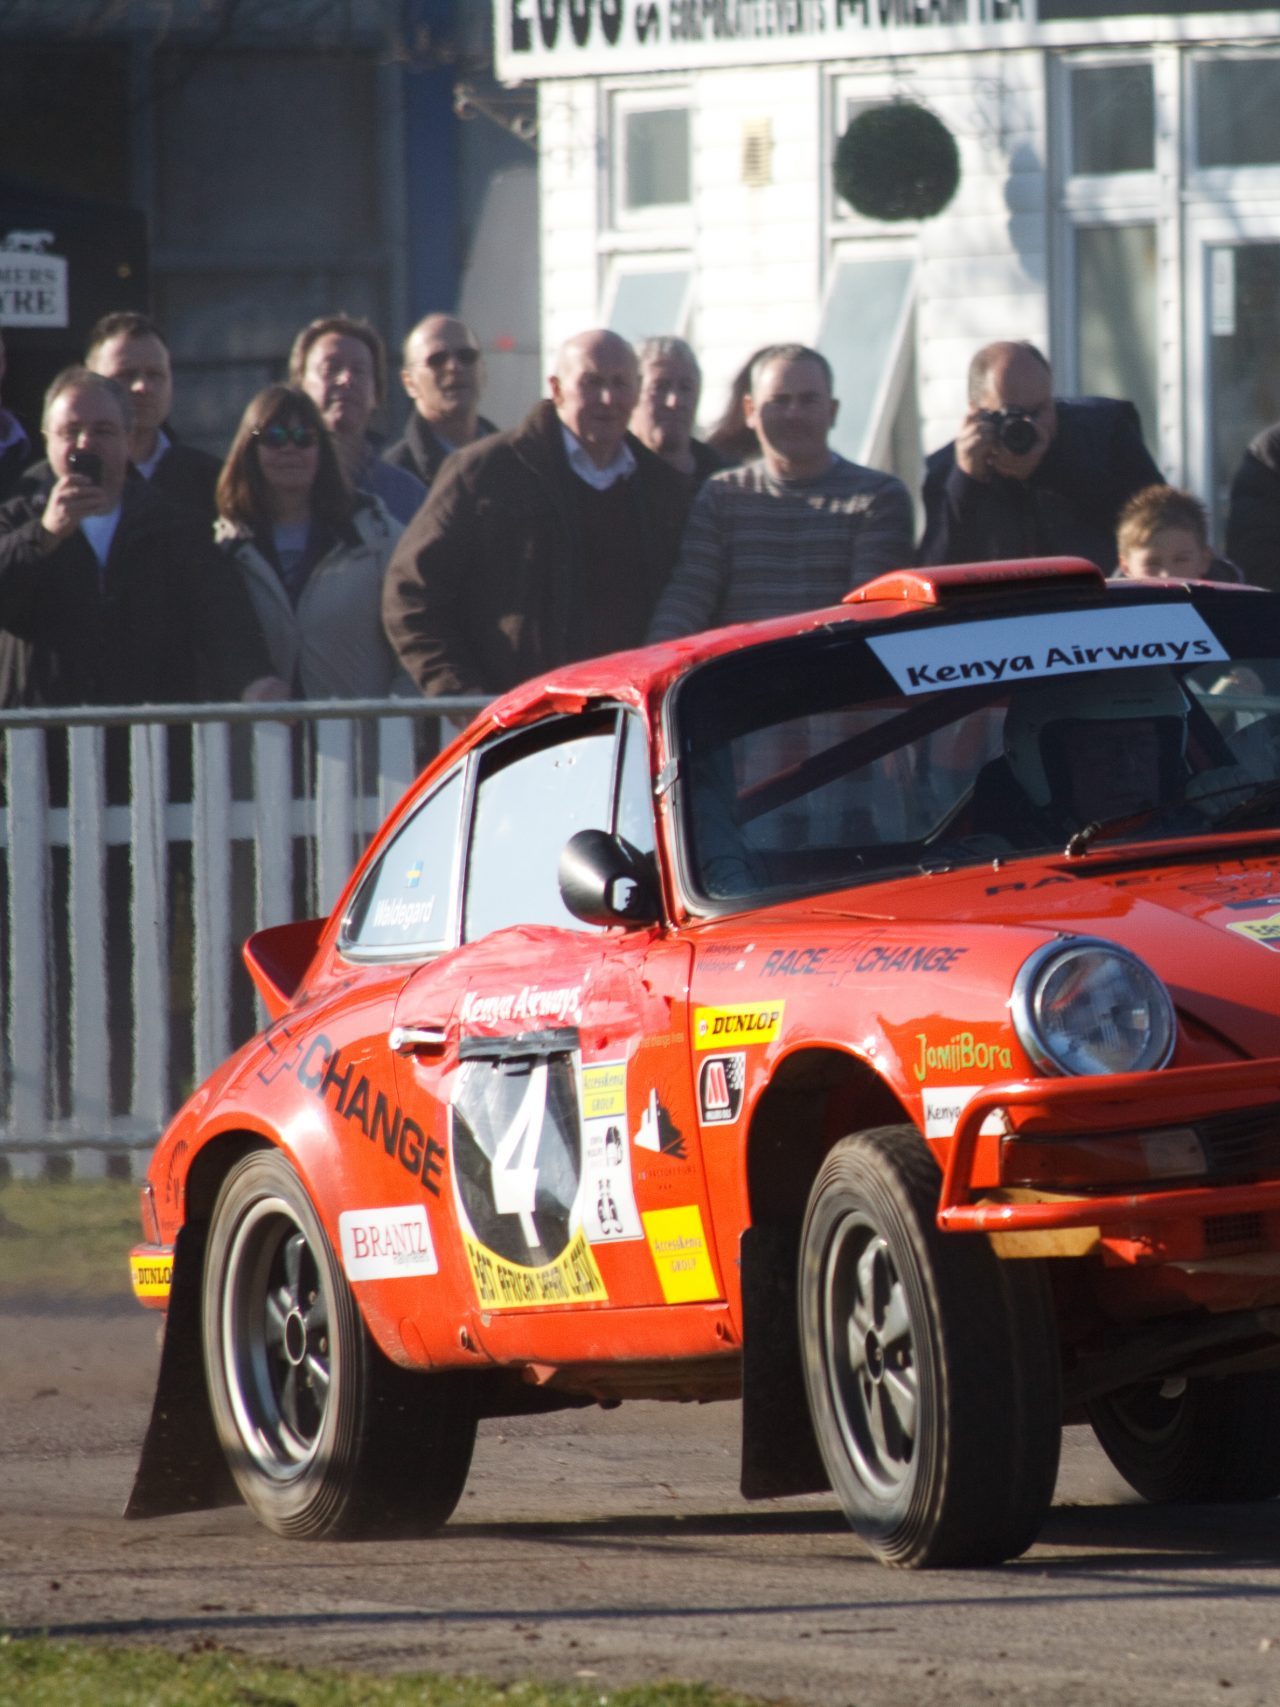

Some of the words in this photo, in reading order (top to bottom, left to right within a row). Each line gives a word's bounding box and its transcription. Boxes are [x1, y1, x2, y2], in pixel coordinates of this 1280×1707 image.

[906, 652, 1033, 688] Kenya
[1045, 638, 1213, 669] Airways
[759, 947, 829, 977] RACE
[855, 946, 970, 973] CHANGE
[460, 991, 514, 1028] Kenya
[513, 984, 583, 1022] Airways
[712, 1011, 780, 1035] DUNLOP
[913, 1032, 1013, 1082] JamiiBora
[296, 1033, 445, 1198] CHANGE
[926, 1103, 961, 1124] Kenya
[491, 1054, 548, 1248] 4
[350, 1221, 428, 1259] BRANTZ
[138, 1266, 174, 1285] DUNLO
